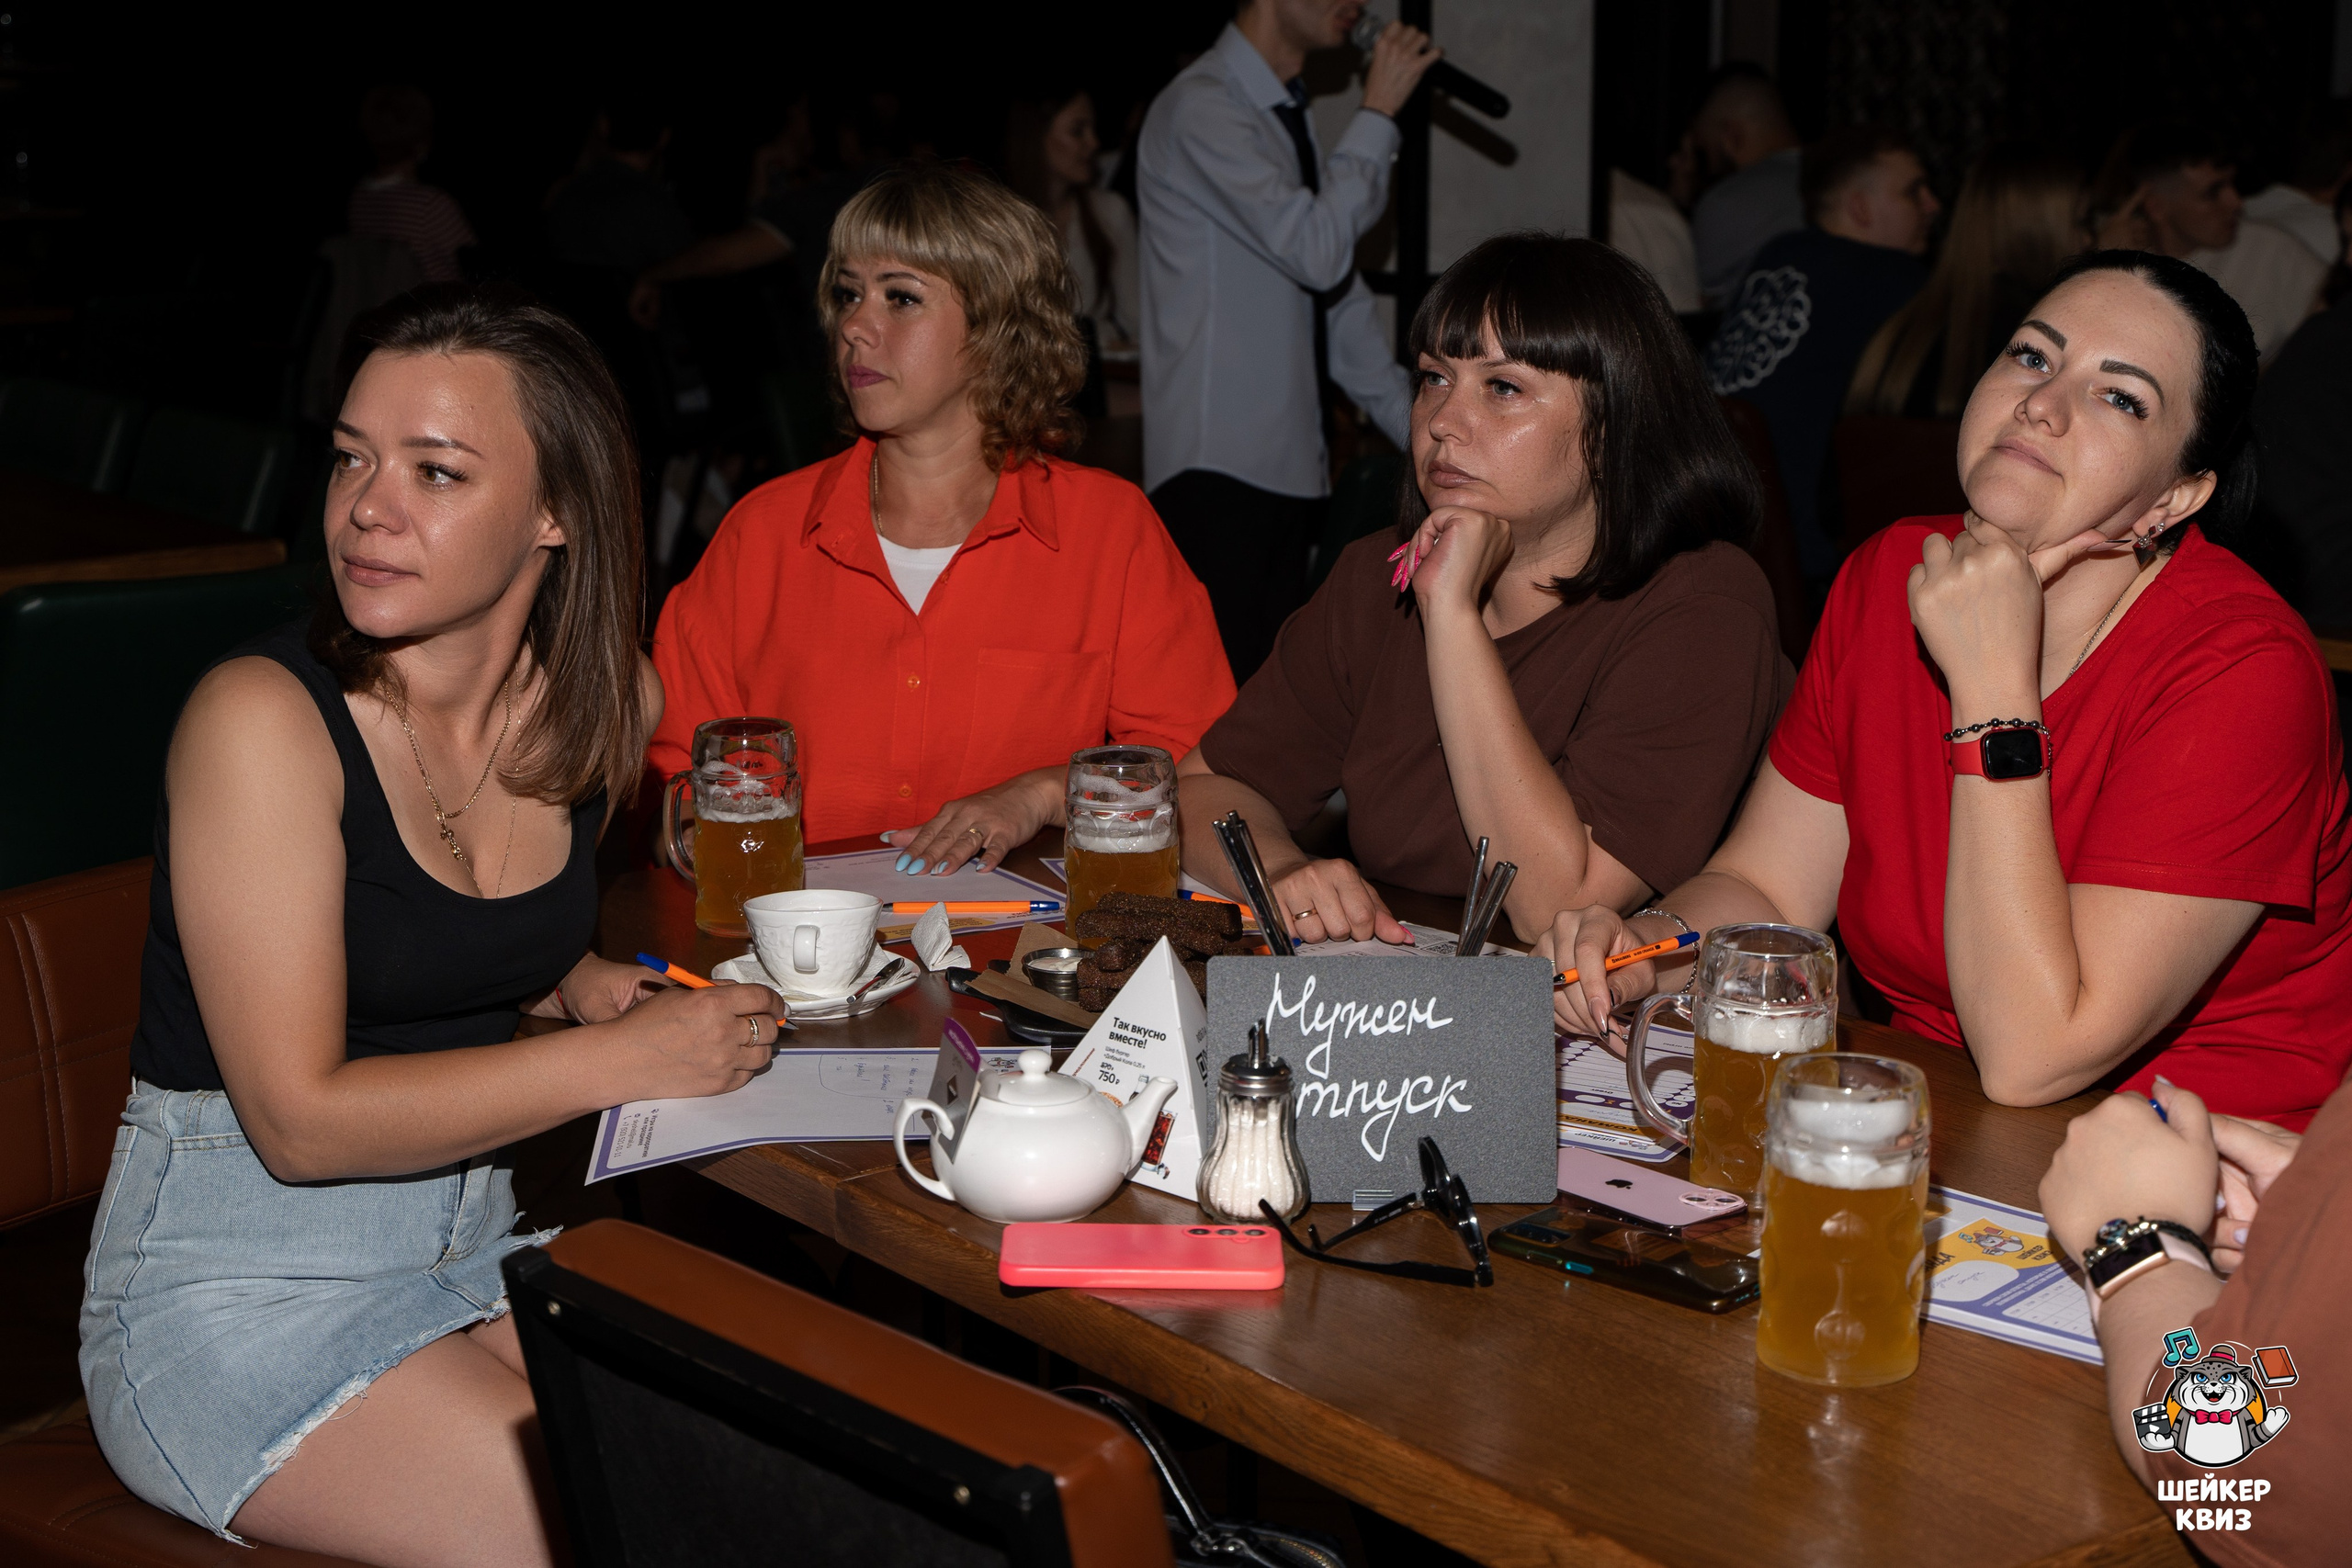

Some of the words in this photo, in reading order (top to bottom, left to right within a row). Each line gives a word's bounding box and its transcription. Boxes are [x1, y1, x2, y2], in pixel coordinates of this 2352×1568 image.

[1109, 1031, 1148, 1049] вместе!
[1114, 1017, 1129, 1031] Так
[1131, 1023, 1167, 1042] вкусно
[1295, 1075, 1473, 1162] тпуск
[1574, 1132, 1617, 1143] ШЕЙКЕР
